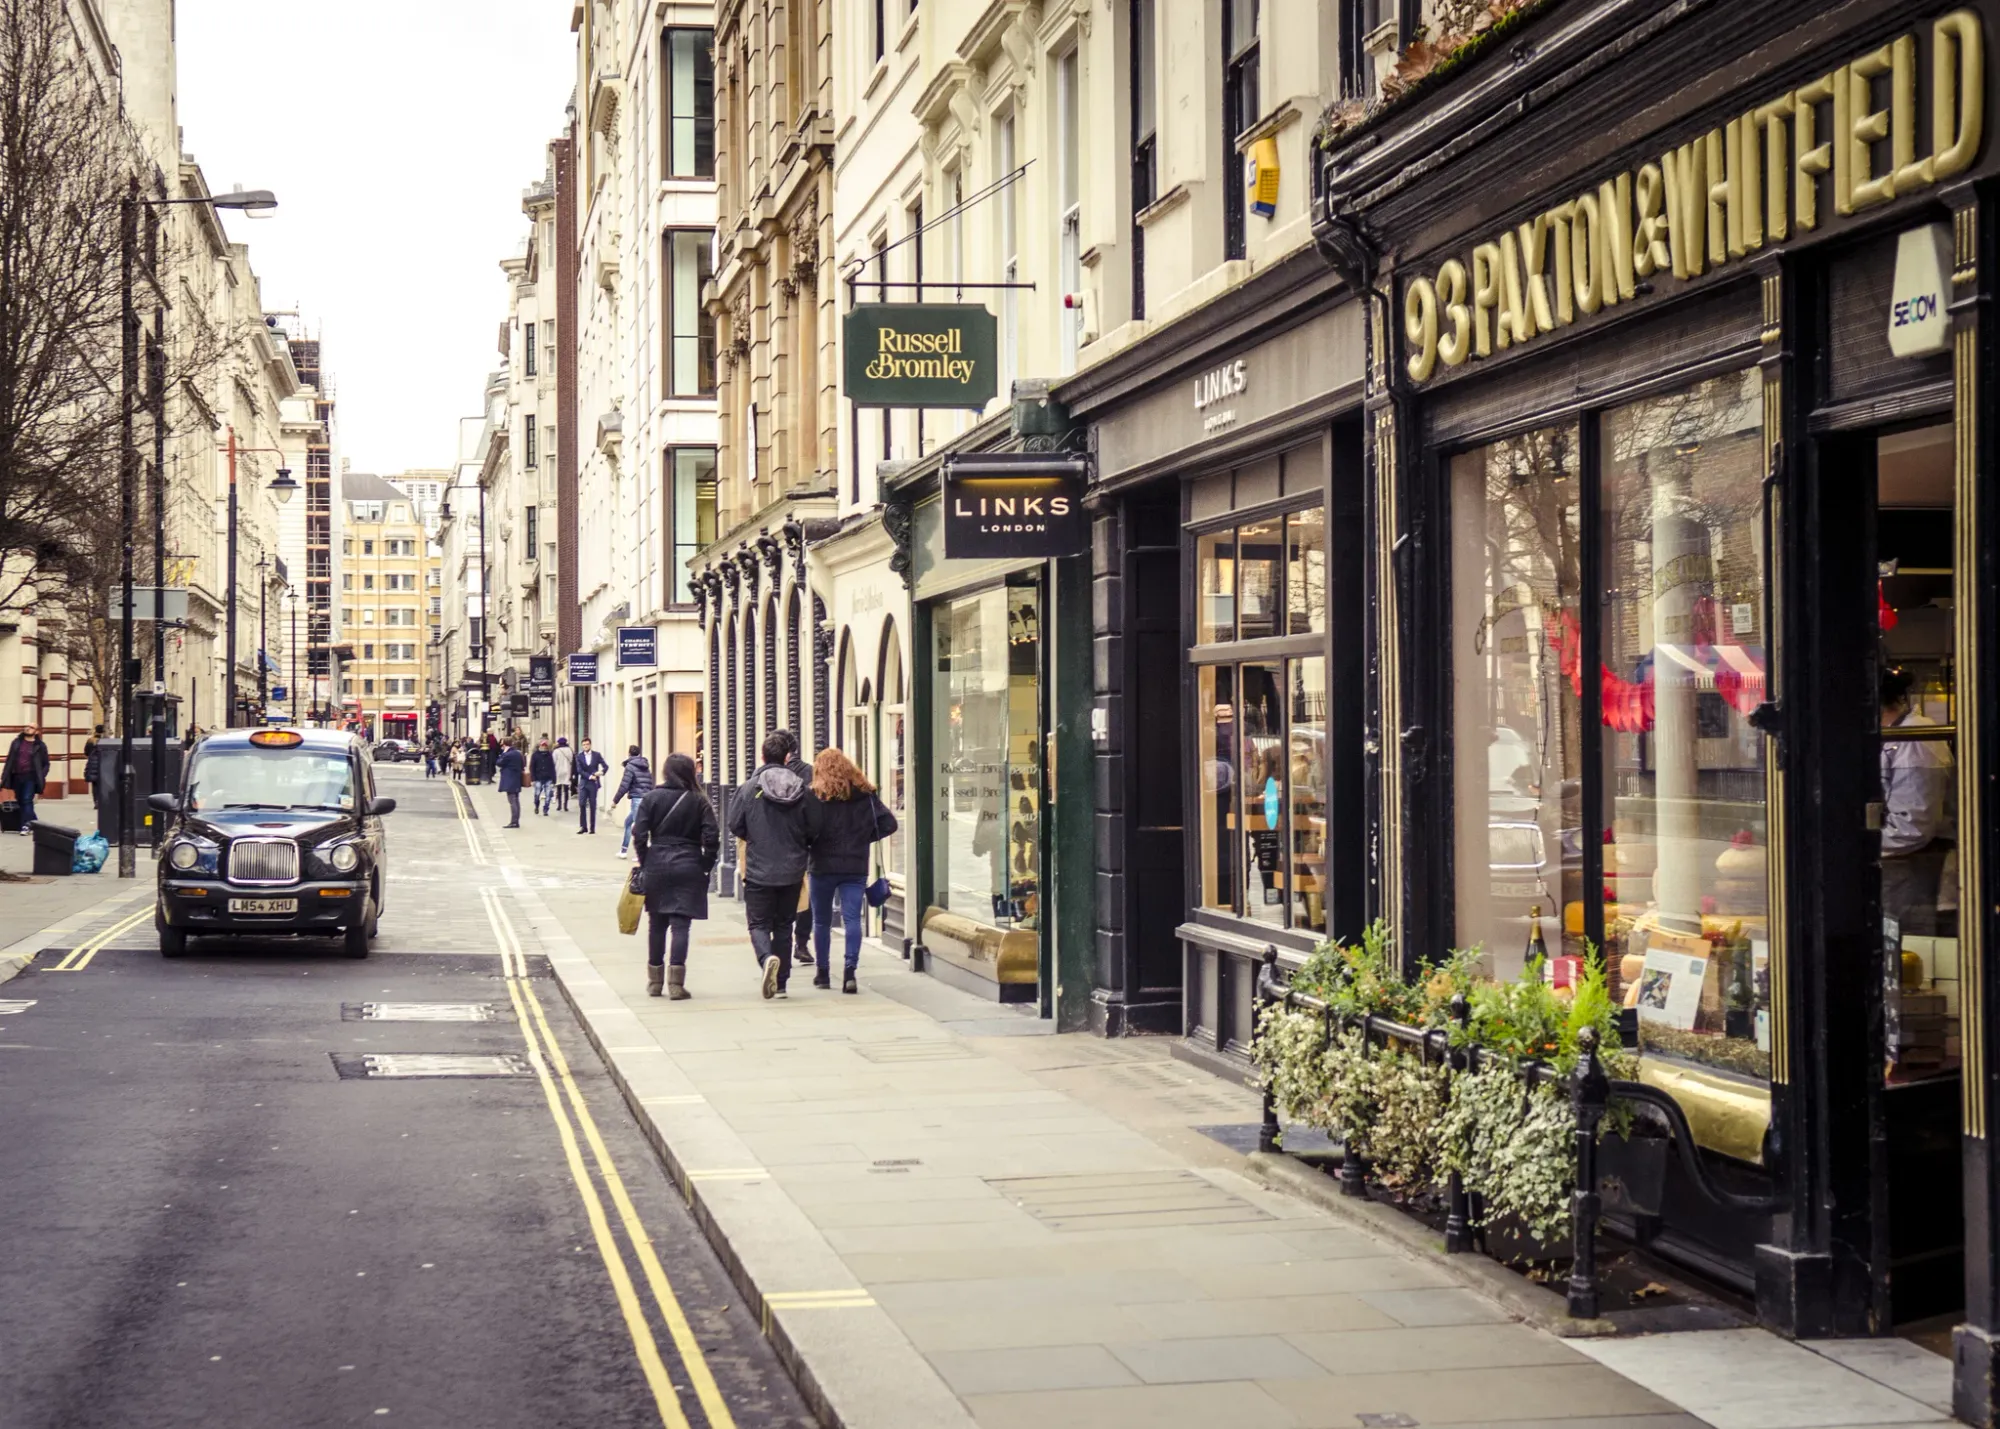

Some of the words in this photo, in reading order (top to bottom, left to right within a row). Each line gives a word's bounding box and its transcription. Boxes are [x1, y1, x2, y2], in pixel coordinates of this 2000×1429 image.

[1894, 293, 1937, 327] SECOM
[878, 327, 962, 354] Russell
[1194, 359, 1247, 410] LINKS
[955, 497, 1070, 517] LINKS
[980, 524, 1046, 533] LONDON
[268, 900, 293, 912] XHU
